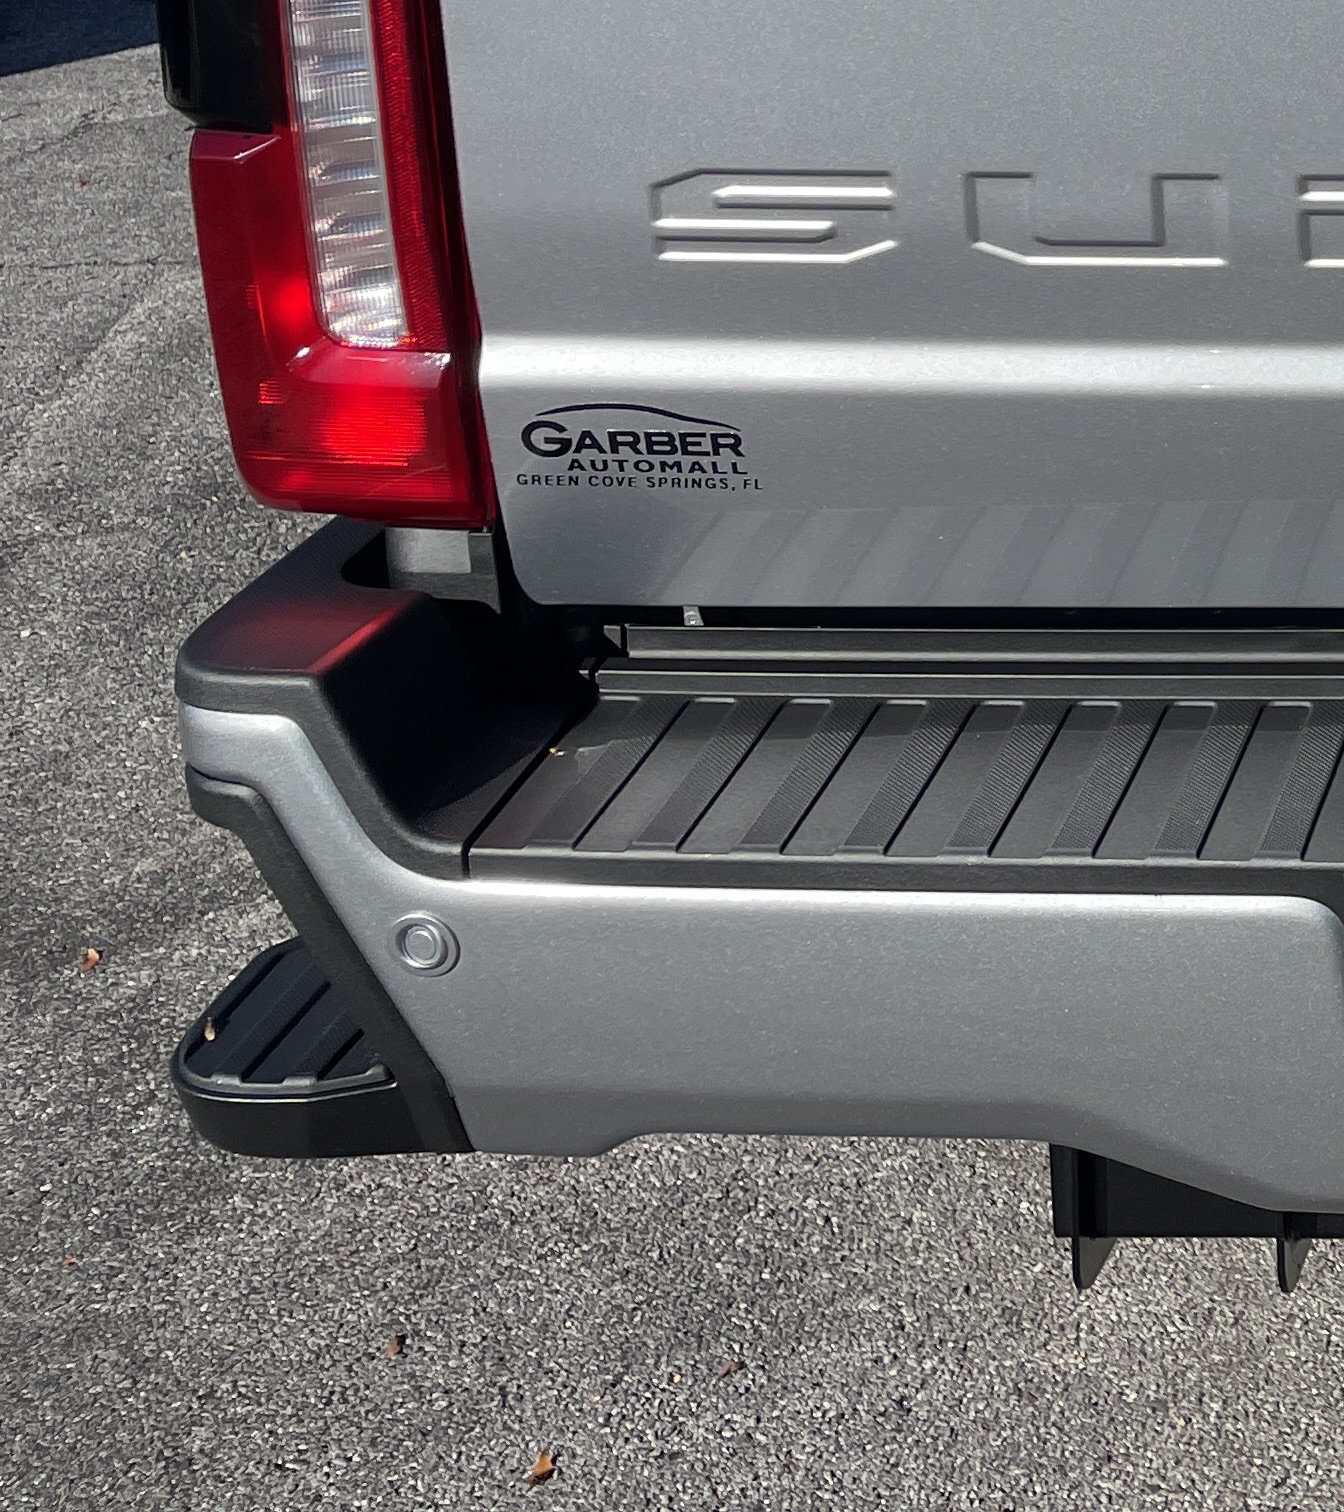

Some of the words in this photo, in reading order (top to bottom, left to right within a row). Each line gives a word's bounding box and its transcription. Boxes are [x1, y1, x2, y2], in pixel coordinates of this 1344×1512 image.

[521, 420, 746, 457] GARBER
[567, 458, 748, 475] AUTOMALL
[516, 473, 579, 487] GREEN
[588, 475, 637, 488] COVE
[647, 476, 737, 491] SPRINGS,
[744, 478, 763, 490] FL
